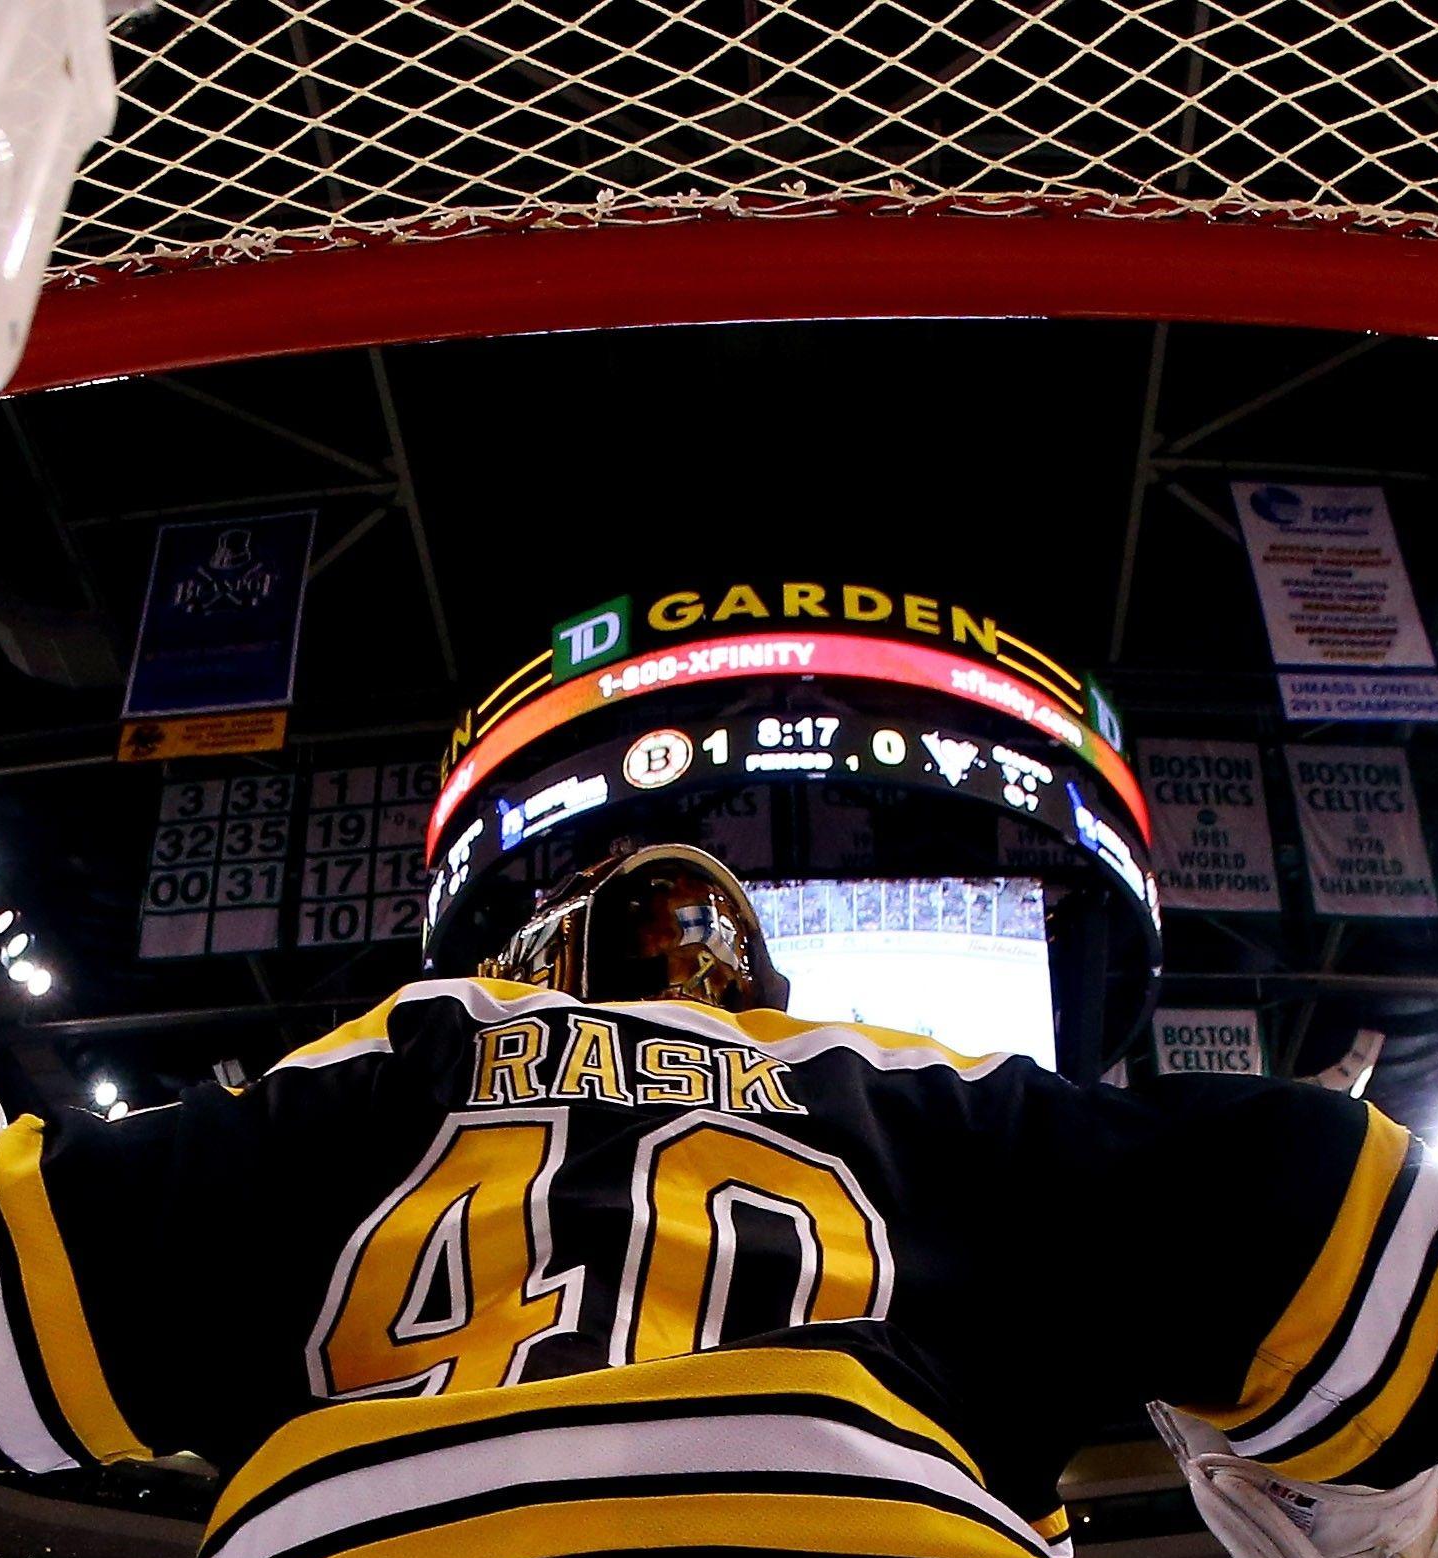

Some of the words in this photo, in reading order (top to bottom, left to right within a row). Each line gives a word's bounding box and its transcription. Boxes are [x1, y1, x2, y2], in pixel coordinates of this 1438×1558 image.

[559, 611, 622, 665] TD
[647, 583, 998, 654] GARDEN
[598, 641, 816, 698] 1-800-XFINITY
[951, 668, 1084, 748] xfinity.com
[702, 728, 729, 765] 1
[757, 716, 840, 749] 8:17
[871, 728, 907, 766] 0
[845, 753, 860, 772] 1
[1148, 755, 1254, 781] BOSTON
[1296, 760, 1402, 785] BOSTON
[231, 775, 291, 813] 33
[329, 772, 349, 810] 1
[390, 764, 439, 800] 16
[1155, 781, 1254, 807] CELTICS
[1307, 788, 1404, 813] CELTICS
[177, 784, 206, 818] 3
[155, 825, 214, 862] 32
[225, 817, 286, 855] 35
[316, 812, 366, 849] 19
[309, 858, 361, 897] 17
[1176, 850, 1247, 870] WORLD
[1335, 855, 1404, 876] WORLD
[149, 867, 211, 907] 00
[226, 866, 279, 902] 31
[306, 903, 360, 942] 10
[1162, 1025, 1252, 1047] BOSTON
[467, 1012, 809, 1116] RASK
[1168, 1047, 1251, 1073] CELTICS
[305, 1106, 895, 1399] 40
